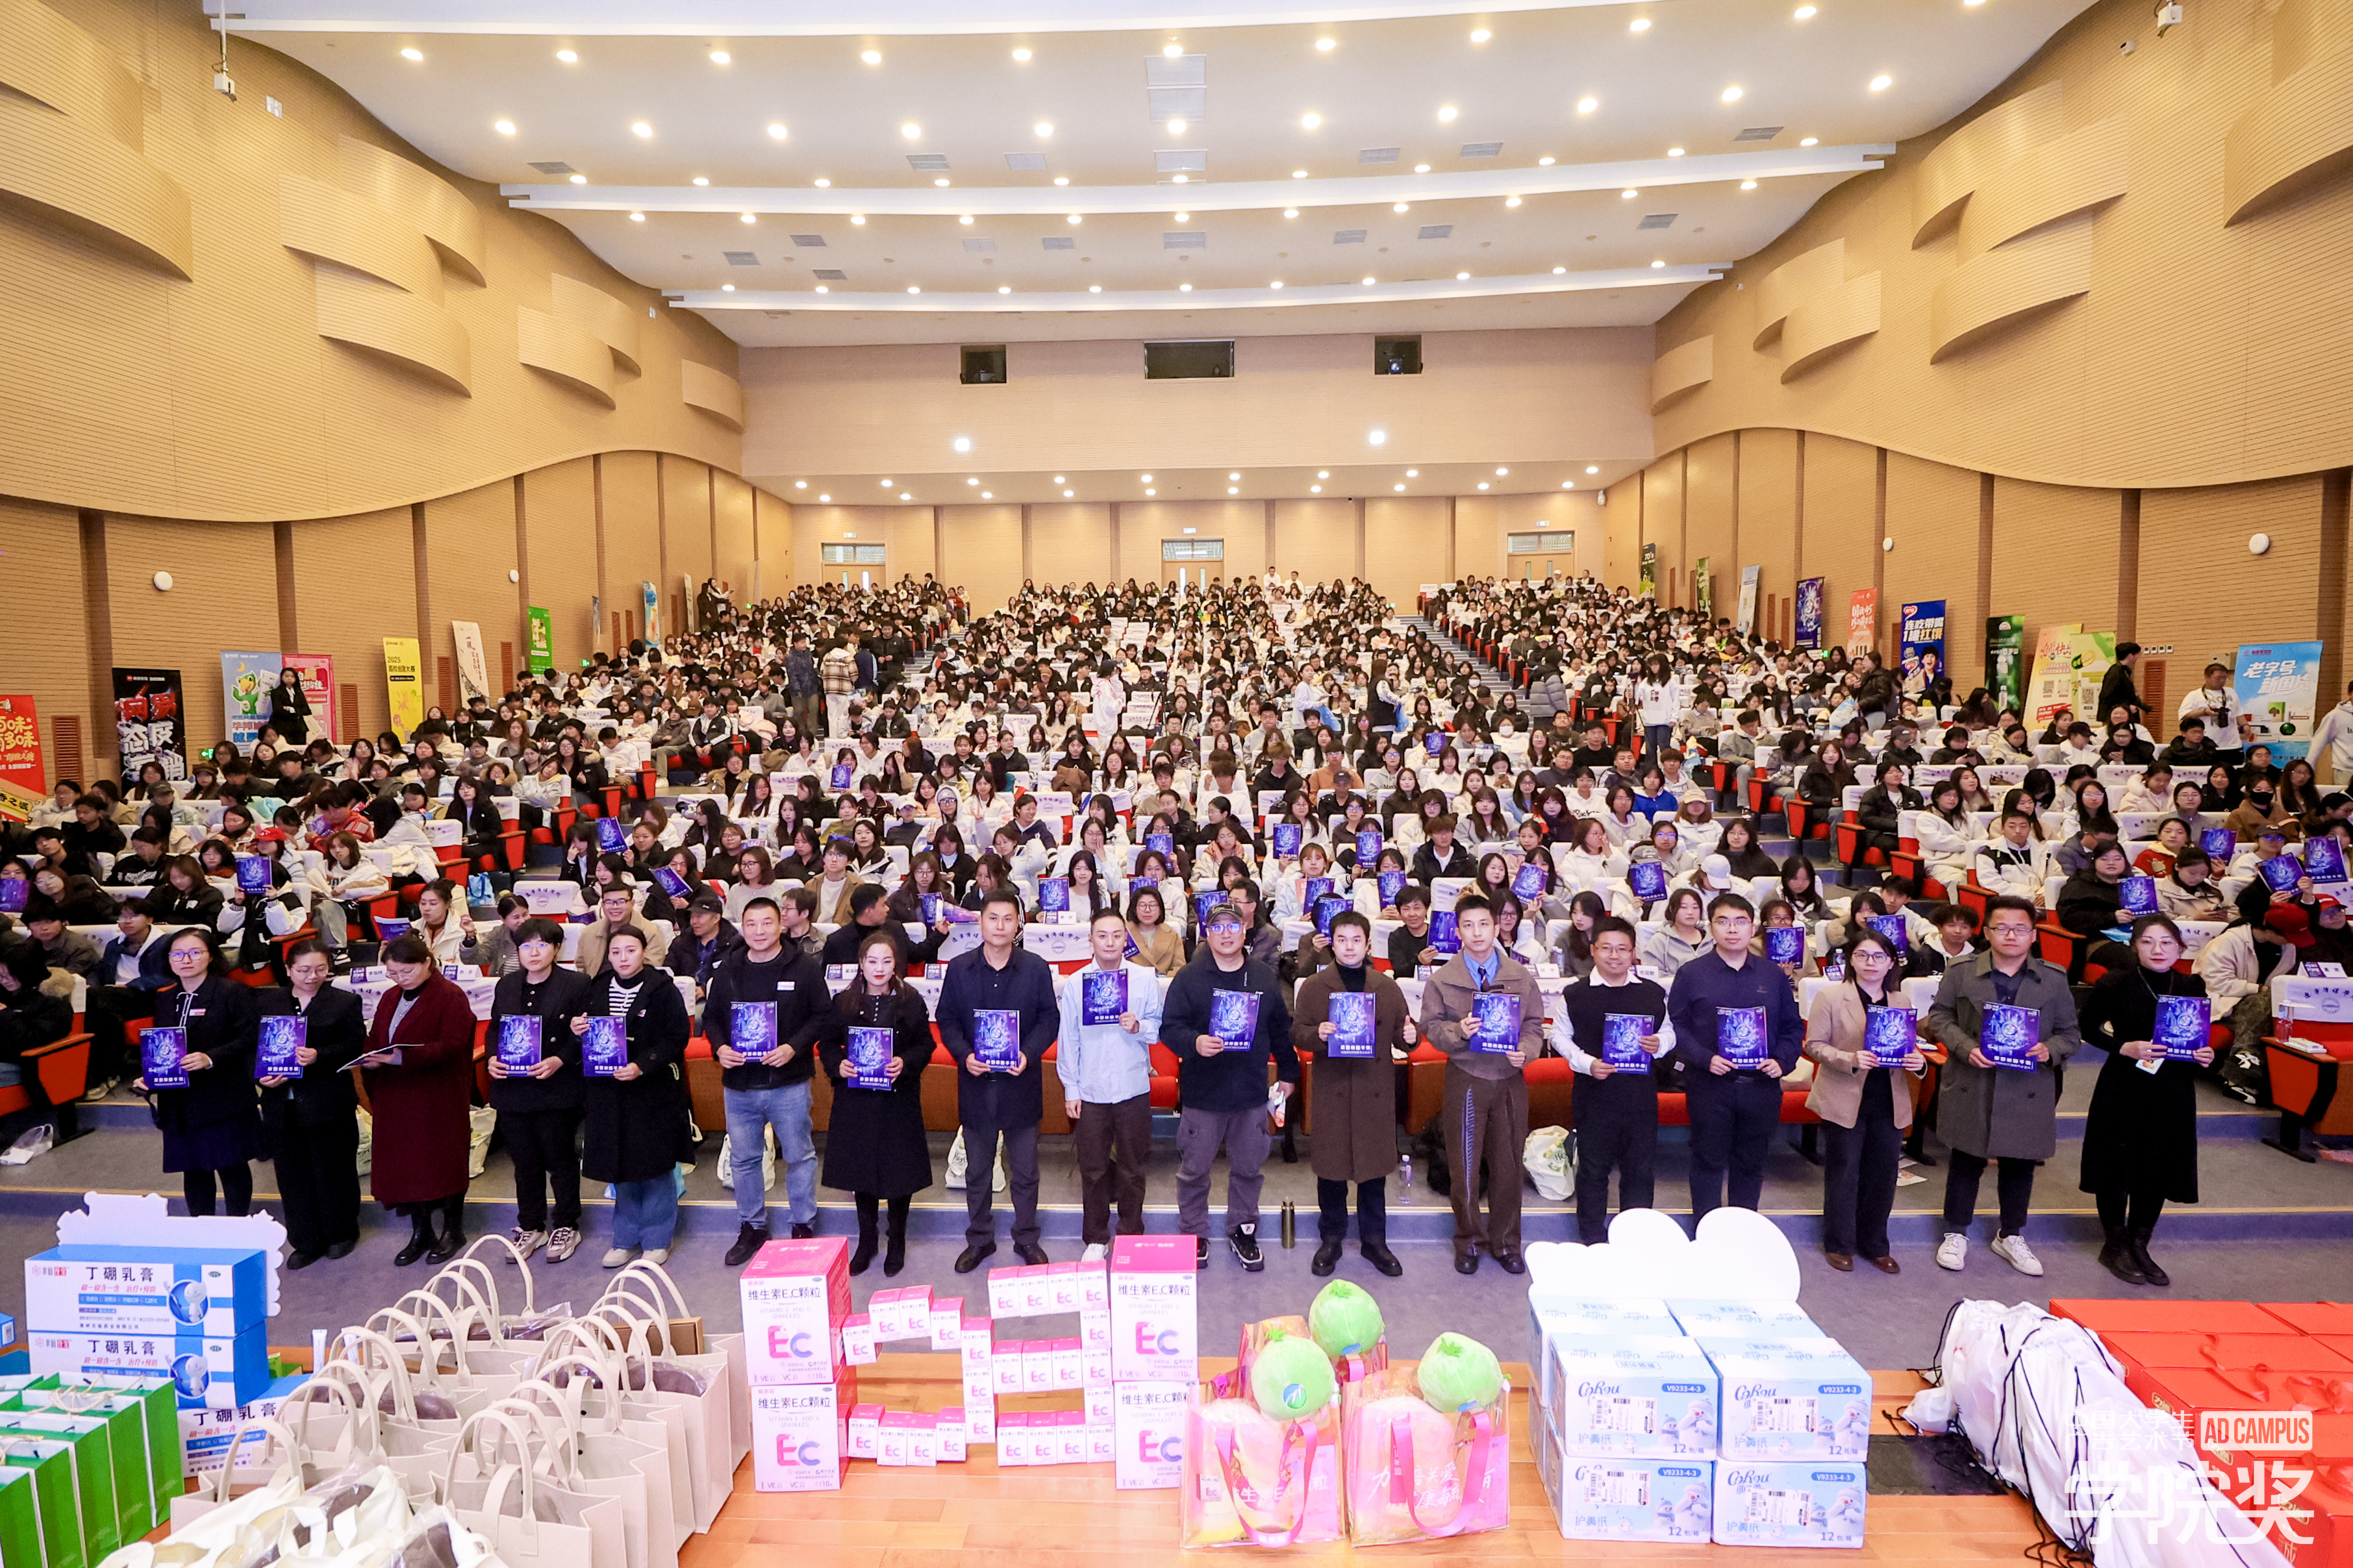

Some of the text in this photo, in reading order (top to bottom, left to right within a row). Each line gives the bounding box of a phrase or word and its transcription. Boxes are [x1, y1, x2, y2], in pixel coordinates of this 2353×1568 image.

[2243, 660, 2296, 678] 老字号
[2258, 675, 2311, 695] 新国货
[116, 721, 174, 753] 态度
[86, 1267, 153, 1282] 丁硼乳膏
[88, 1339, 155, 1356] 丁硼乳膏
[194, 1402, 276, 1426] 丁硼乳膏
